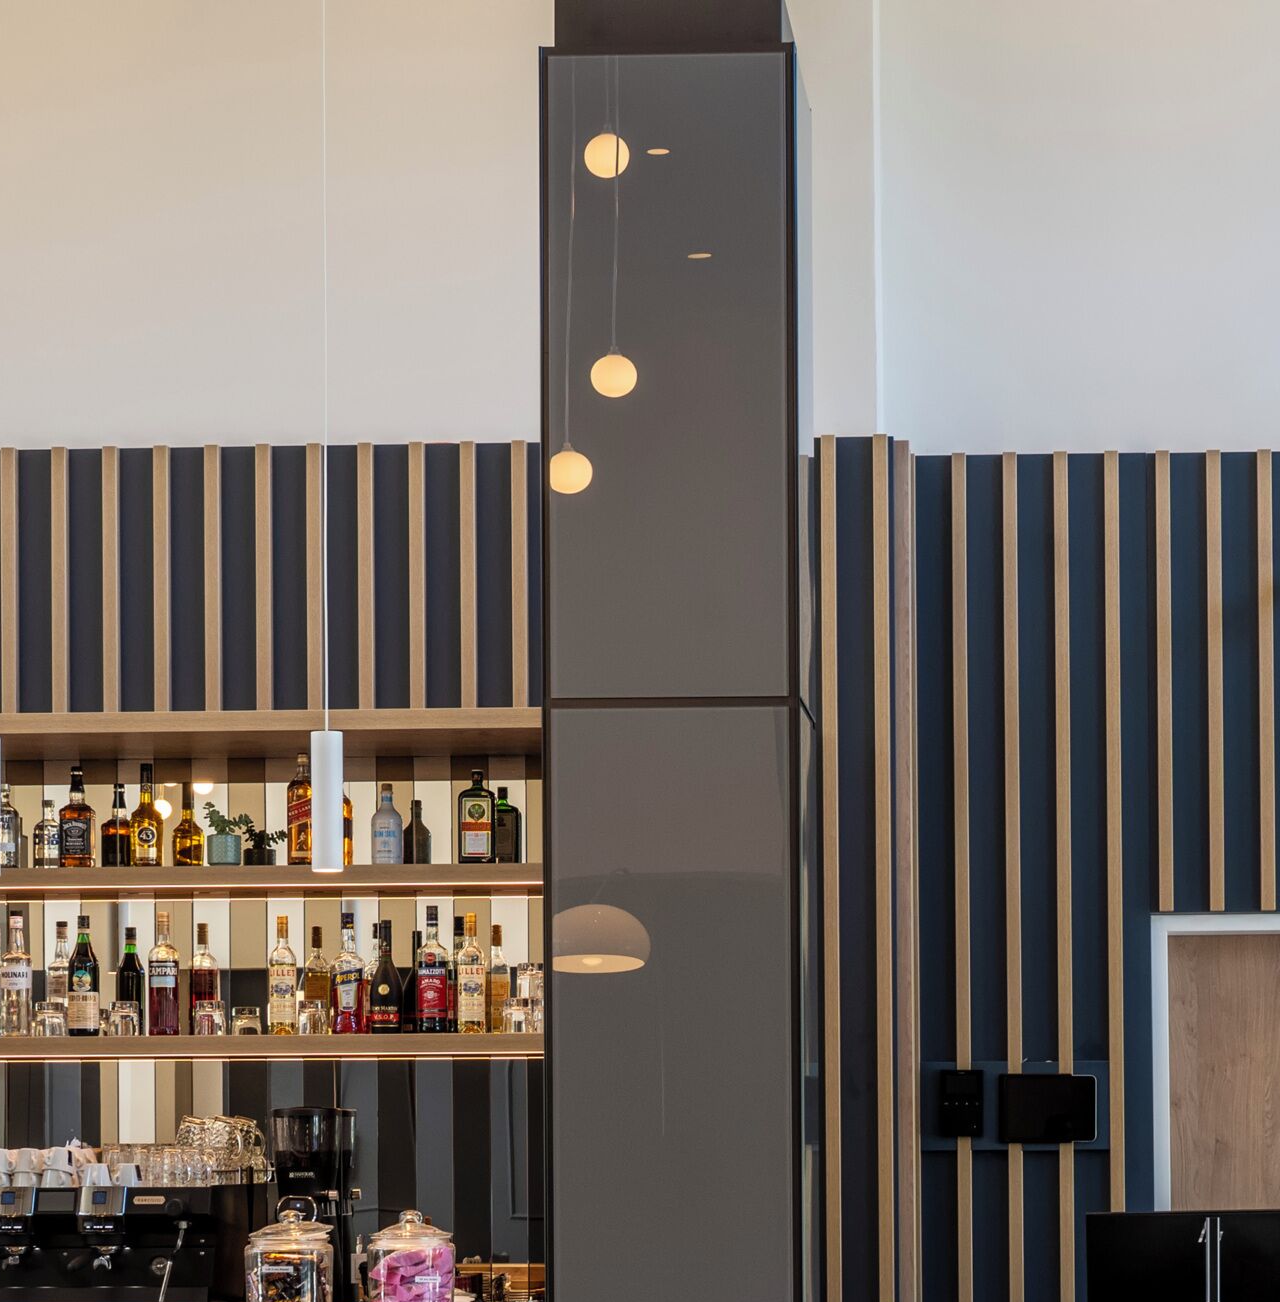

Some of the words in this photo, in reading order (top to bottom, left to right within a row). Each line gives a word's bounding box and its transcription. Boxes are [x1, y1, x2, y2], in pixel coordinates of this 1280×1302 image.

[288, 809, 298, 817] RED
[139, 830, 153, 840] 43
[149, 967, 178, 976] CAMPARI
[269, 968, 295, 977] LILLET
[458, 967, 484, 976] LILLET
[335, 971, 360, 984] APEROL
